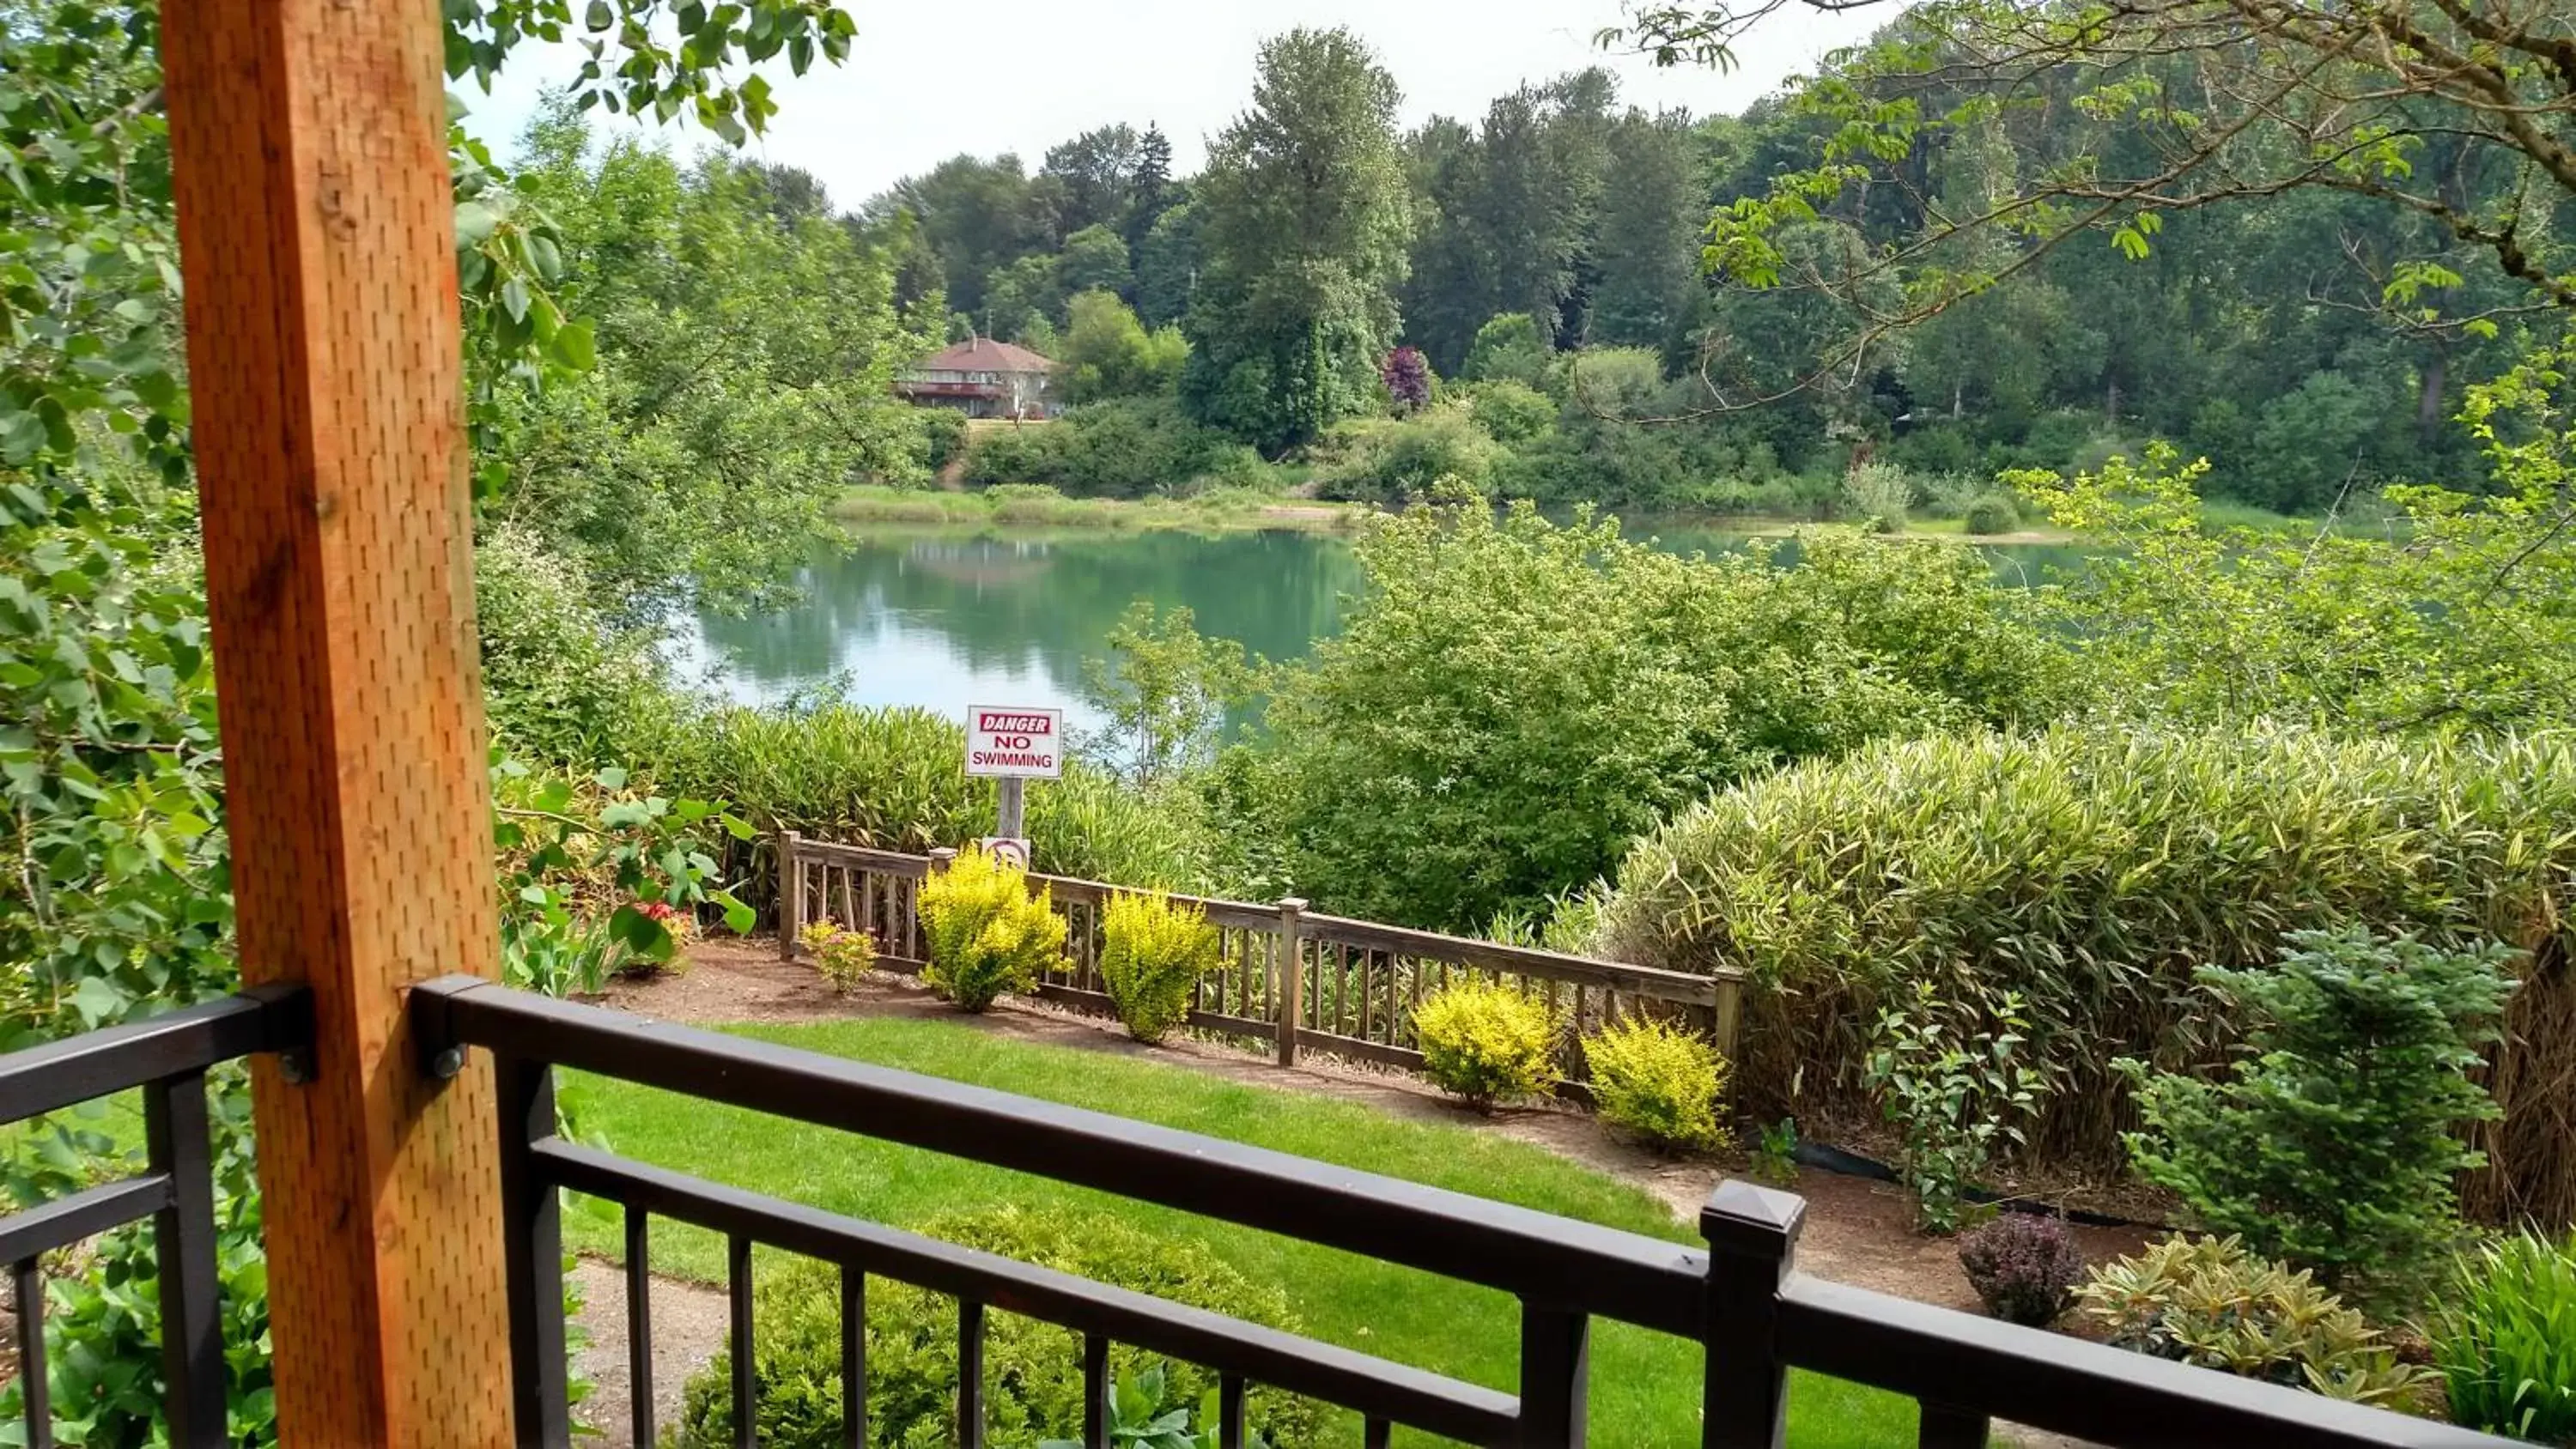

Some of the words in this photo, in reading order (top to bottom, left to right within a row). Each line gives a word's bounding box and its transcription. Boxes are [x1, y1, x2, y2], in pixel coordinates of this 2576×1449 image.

[984, 716, 1048, 732] DANGER
[994, 736, 1030, 749] NO
[973, 751, 1052, 768] SWIMMING
